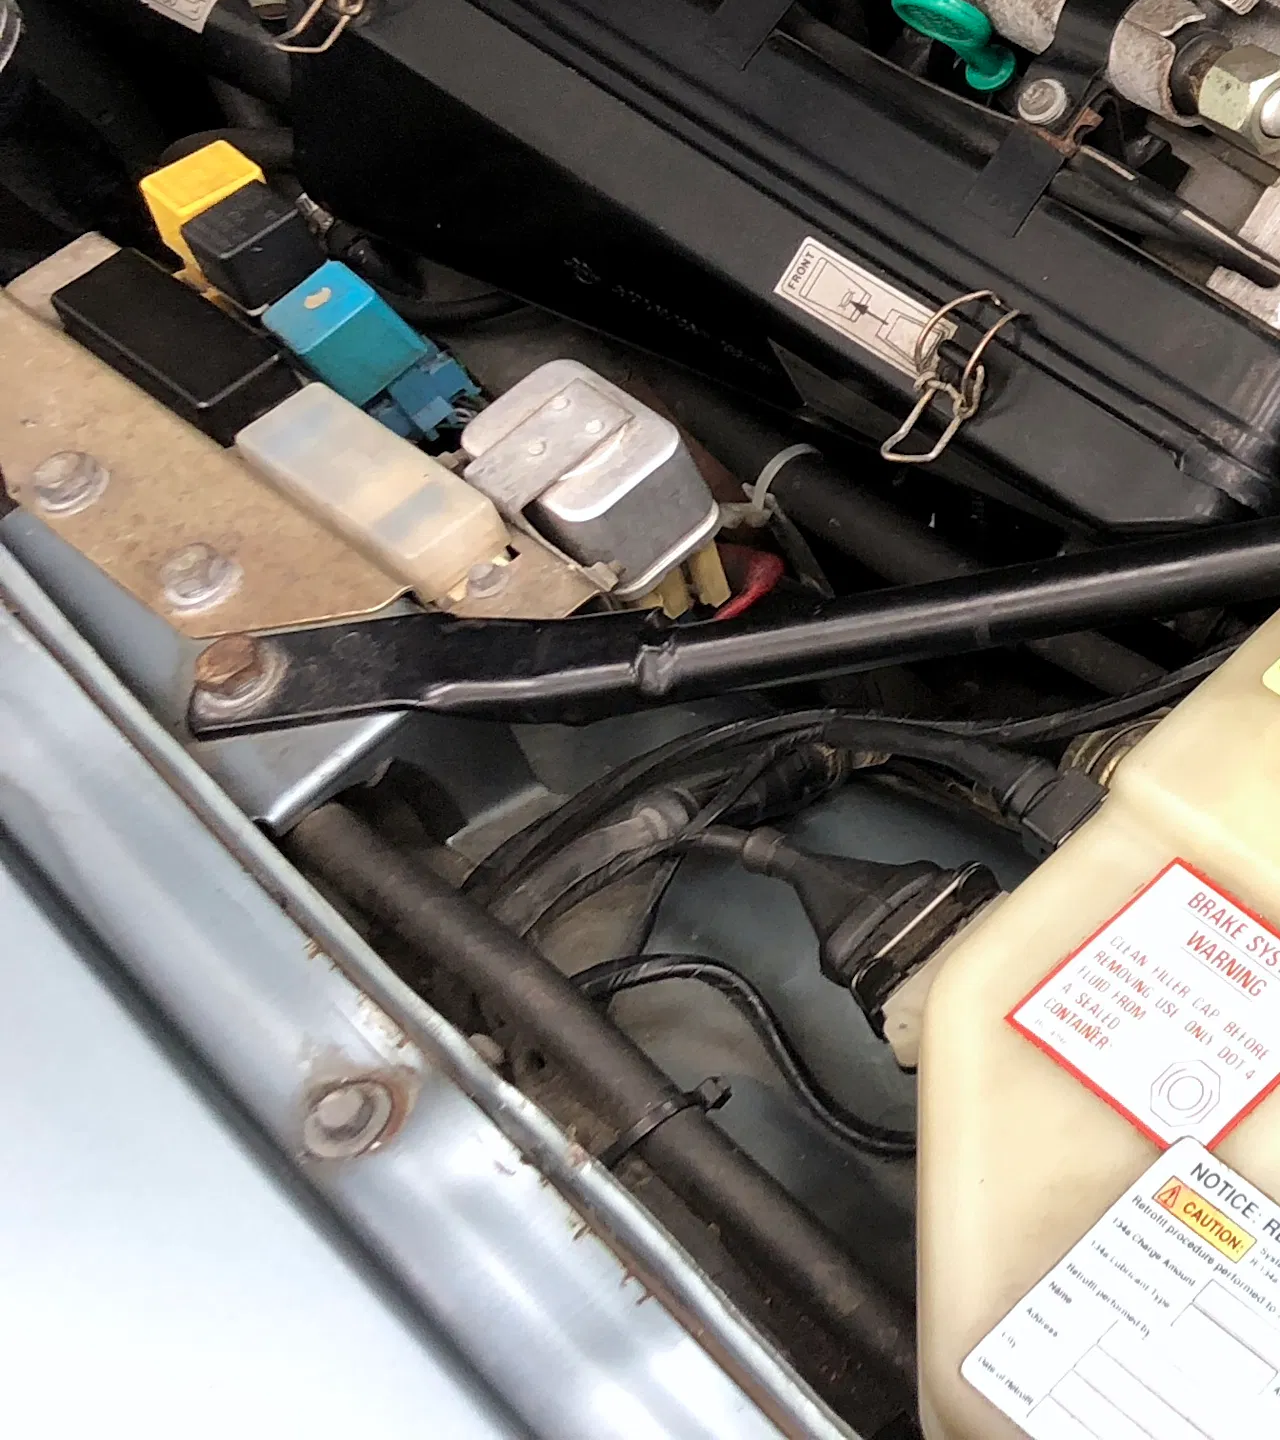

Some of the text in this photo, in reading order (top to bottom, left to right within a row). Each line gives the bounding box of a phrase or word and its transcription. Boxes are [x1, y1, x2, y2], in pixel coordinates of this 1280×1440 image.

[783, 250, 818, 290] FRONT
[1186, 888, 1248, 942] BRAKE
[1075, 963, 1147, 1022] FLUID FROM
[1183, 928, 1268, 999] WARNING
[1042, 995, 1110, 1051] CONTAINER
[1059, 980, 1121, 1031] A SEALED
[1091, 948, 1256, 1081] REMOVING USE ONLY DOT 4
[1108, 933, 1271, 1061] CLEAN FILLER CAP BEFORE
[1188, 1159, 1266, 1226] NOTICE:
[1110, 1216, 1197, 1288] 134a Charge Amount
[1128, 1193, 1170, 1229] Retrofit
[1163, 1222, 1217, 1267] procedure
[1212, 1260, 1267, 1306] performed
[1264, 1299, 1279, 1314] to
[1179, 1197, 1247, 1256] CAUTION:
[1022, 1305, 1062, 1338] Address
[1045, 1279, 1075, 1306] Name
